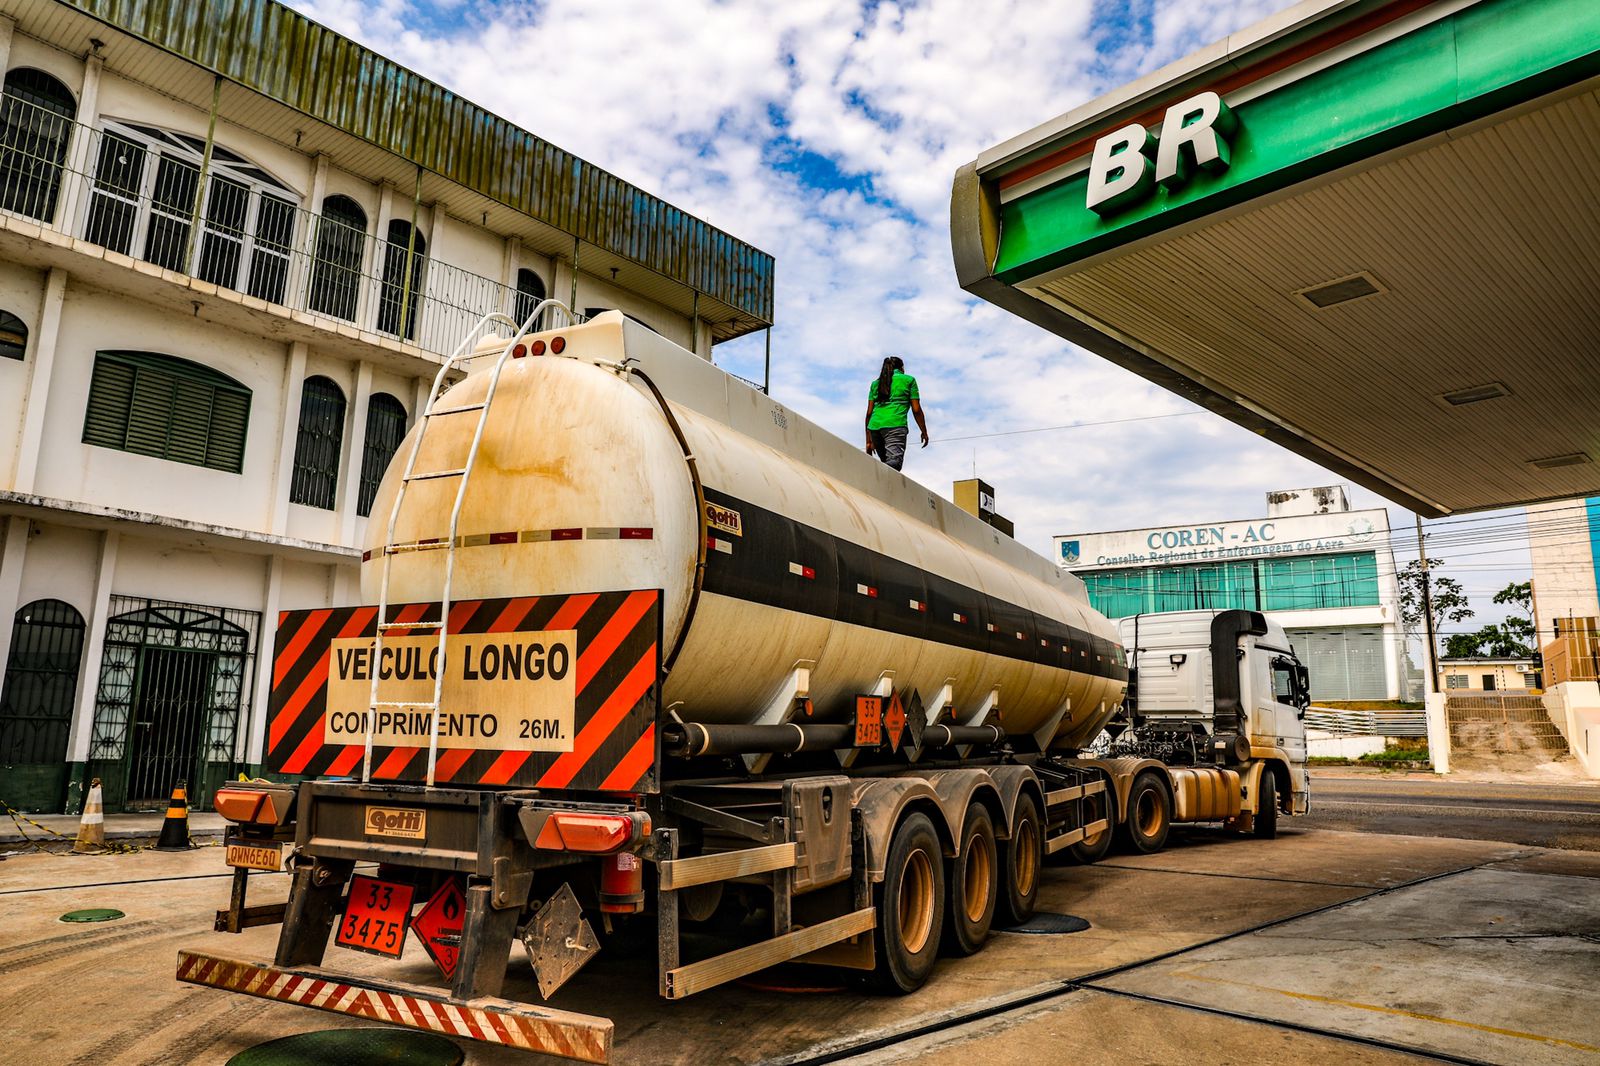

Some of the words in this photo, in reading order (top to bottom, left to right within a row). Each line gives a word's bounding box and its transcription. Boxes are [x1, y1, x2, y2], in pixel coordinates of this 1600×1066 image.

[1086, 91, 1222, 209] BR
[1147, 527, 1225, 550] COREN
[1243, 523, 1276, 543] AC
[1097, 553, 1145, 566] Conselho
[1149, 549, 1198, 565] Regional
[1202, 548, 1214, 559] de
[1218, 543, 1293, 558] Enfermagem
[1297, 541, 1312, 552] do
[1316, 539, 1344, 551] Acre
[337, 641, 447, 681] VEÍCULO
[463, 642, 569, 681] LONGO
[519, 719, 565, 739] 26M.
[367, 883, 394, 912] 33
[345, 914, 399, 948] 3475
